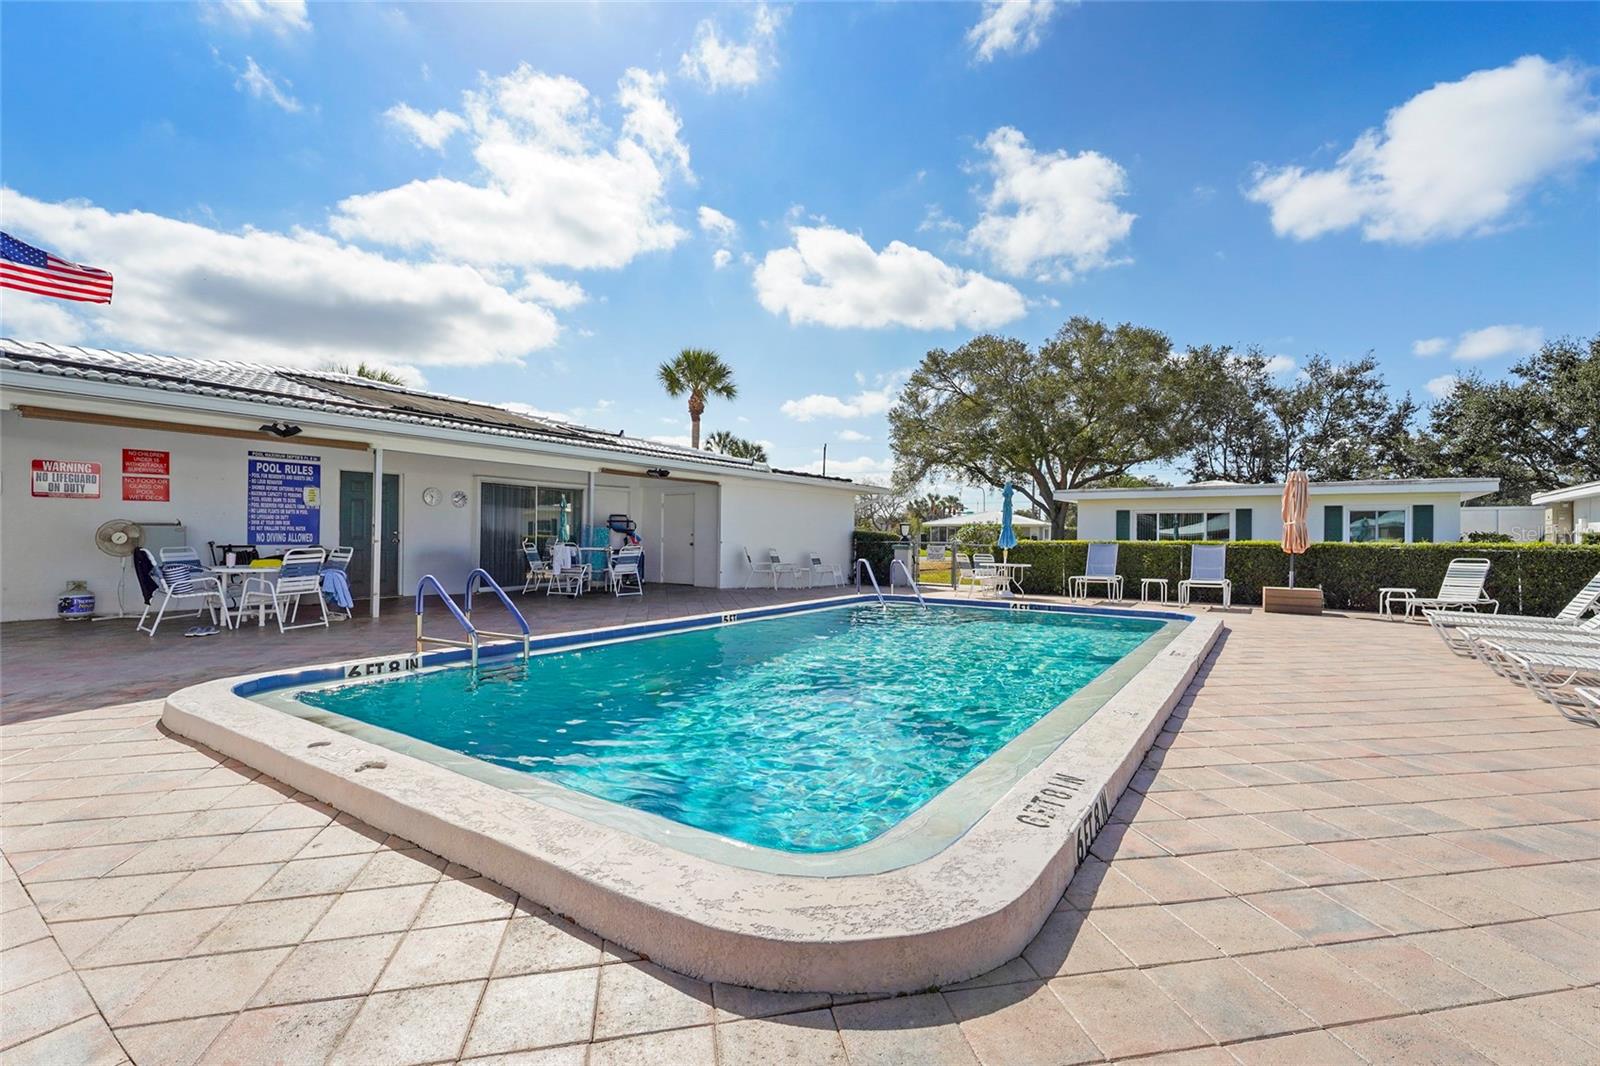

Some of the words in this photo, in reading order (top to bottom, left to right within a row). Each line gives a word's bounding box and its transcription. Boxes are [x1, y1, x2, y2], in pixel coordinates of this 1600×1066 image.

[43, 461, 92, 473] WARNING
[256, 462, 282, 473] POOL
[285, 465, 314, 475] RULES
[36, 472, 48, 482] NO
[52, 473, 97, 484] LIFEGUARD
[48, 483, 60, 492] ON
[64, 483, 85, 493] DUTY
[256, 533, 265, 542] NO
[267, 533, 286, 542] DIVING
[288, 533, 313, 542] ALLOWED
[348, 665, 361, 678] 6
[366, 662, 384, 675] FT
[389, 660, 400, 672] 8
[406, 658, 418, 670] IN
[1077, 826, 1084, 866] 6
[1094, 802, 1100, 834] 8
[1100, 789, 1109, 826] IN
